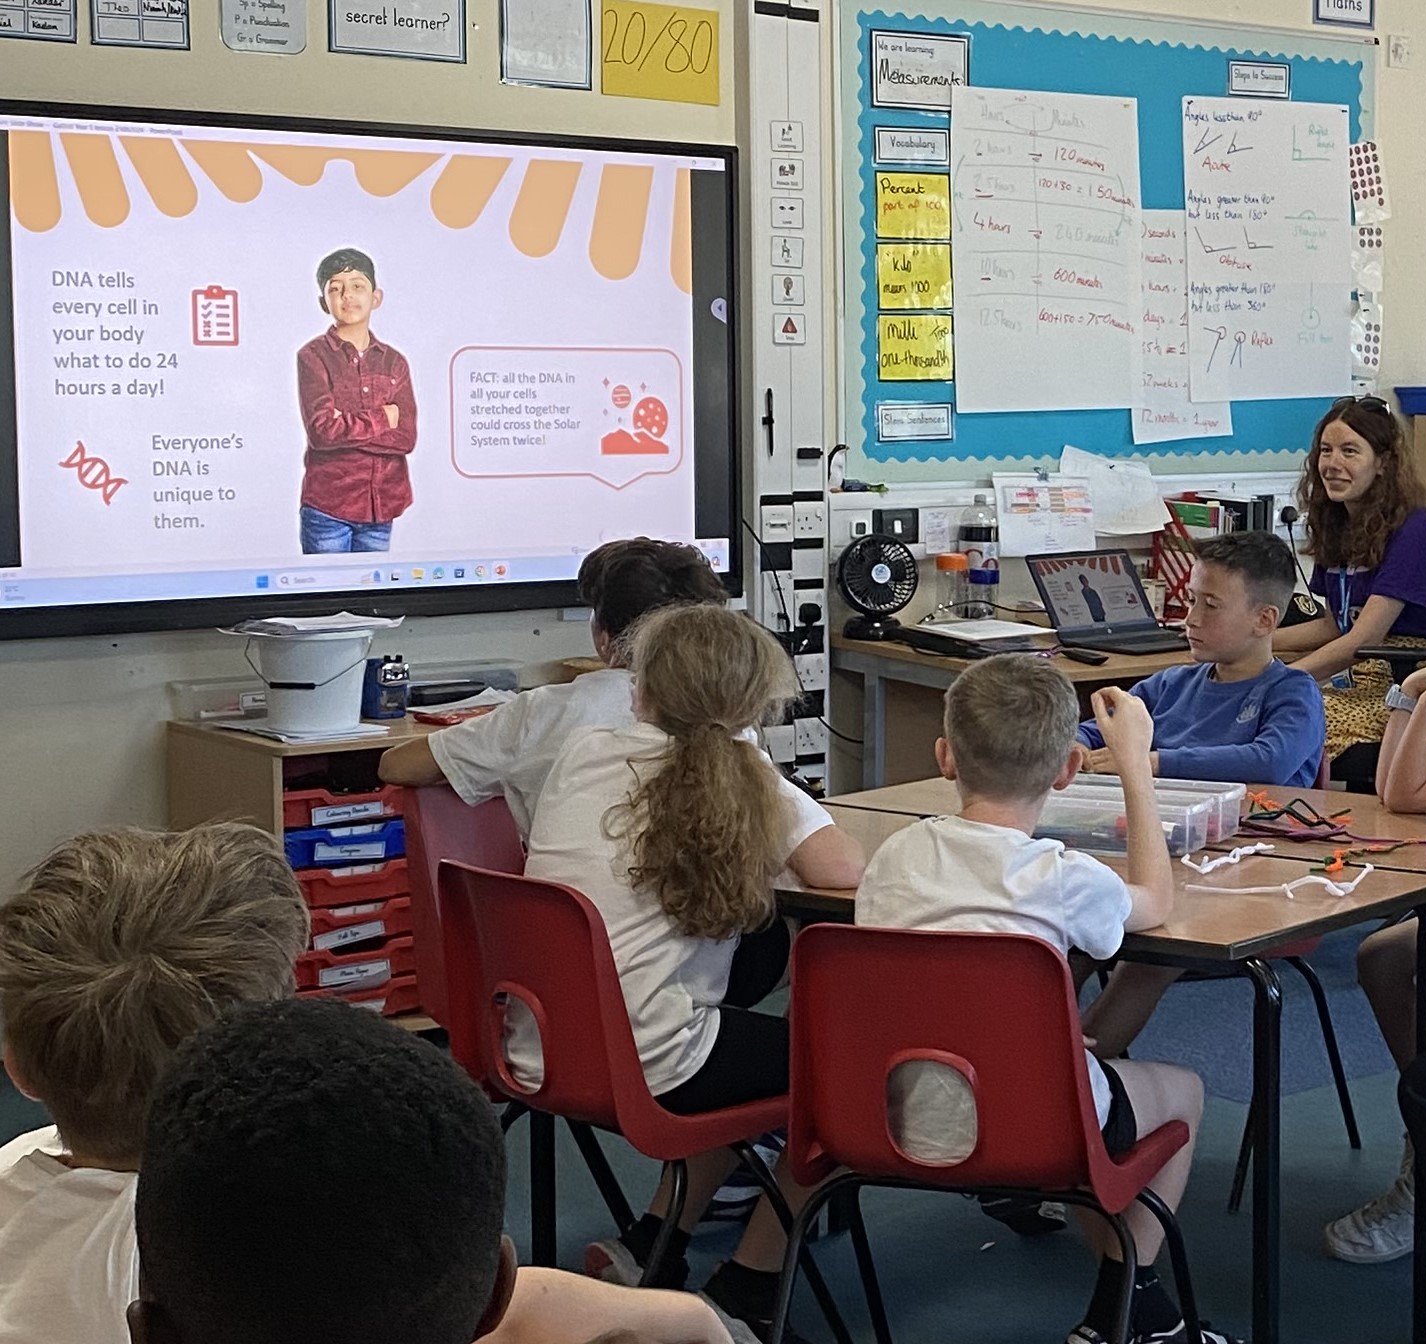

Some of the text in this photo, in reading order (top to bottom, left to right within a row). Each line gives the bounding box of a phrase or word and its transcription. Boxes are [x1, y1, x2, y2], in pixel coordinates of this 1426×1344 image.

[235, 15, 289, 28] P Punctuation
[346, 7, 450, 31] secret learner?
[237, 33, 246, 42] Gr
[604, 10, 712, 74] 20/80
[878, 40, 888, 50] We
[905, 42, 934, 58] learning
[1234, 69, 1284, 83] Steps to Success
[1185, 106, 1209, 126] Angles
[890, 136, 935, 153] Vocabulary
[1054, 147, 1076, 161] 120
[880, 177, 925, 194] Percent
[1187, 189, 1211, 206] Angles
[883, 201, 904, 215] part
[52, 271, 135, 288] DNA tells
[1054, 268, 1076, 283] 600
[53, 299, 158, 318] every cell in
[1143, 312, 1165, 325] days
[53, 325, 144, 344] your body
[54, 352, 178, 369] what to do 24
[470, 372, 575, 384] FACT: all the DNA in
[55, 379, 165, 398] hours a day!
[470, 388, 537, 403] all your cells
[470, 403, 571, 417] stretched together
[907, 412, 945, 424] Sentences
[470, 419, 580, 431] could cross the Solar
[152, 433, 244, 453] Everyone’s
[471, 434, 546, 448] System twice!
[153, 460, 209, 476] DNA is
[154, 485, 236, 504] unique to
[154, 514, 205, 529] them.
